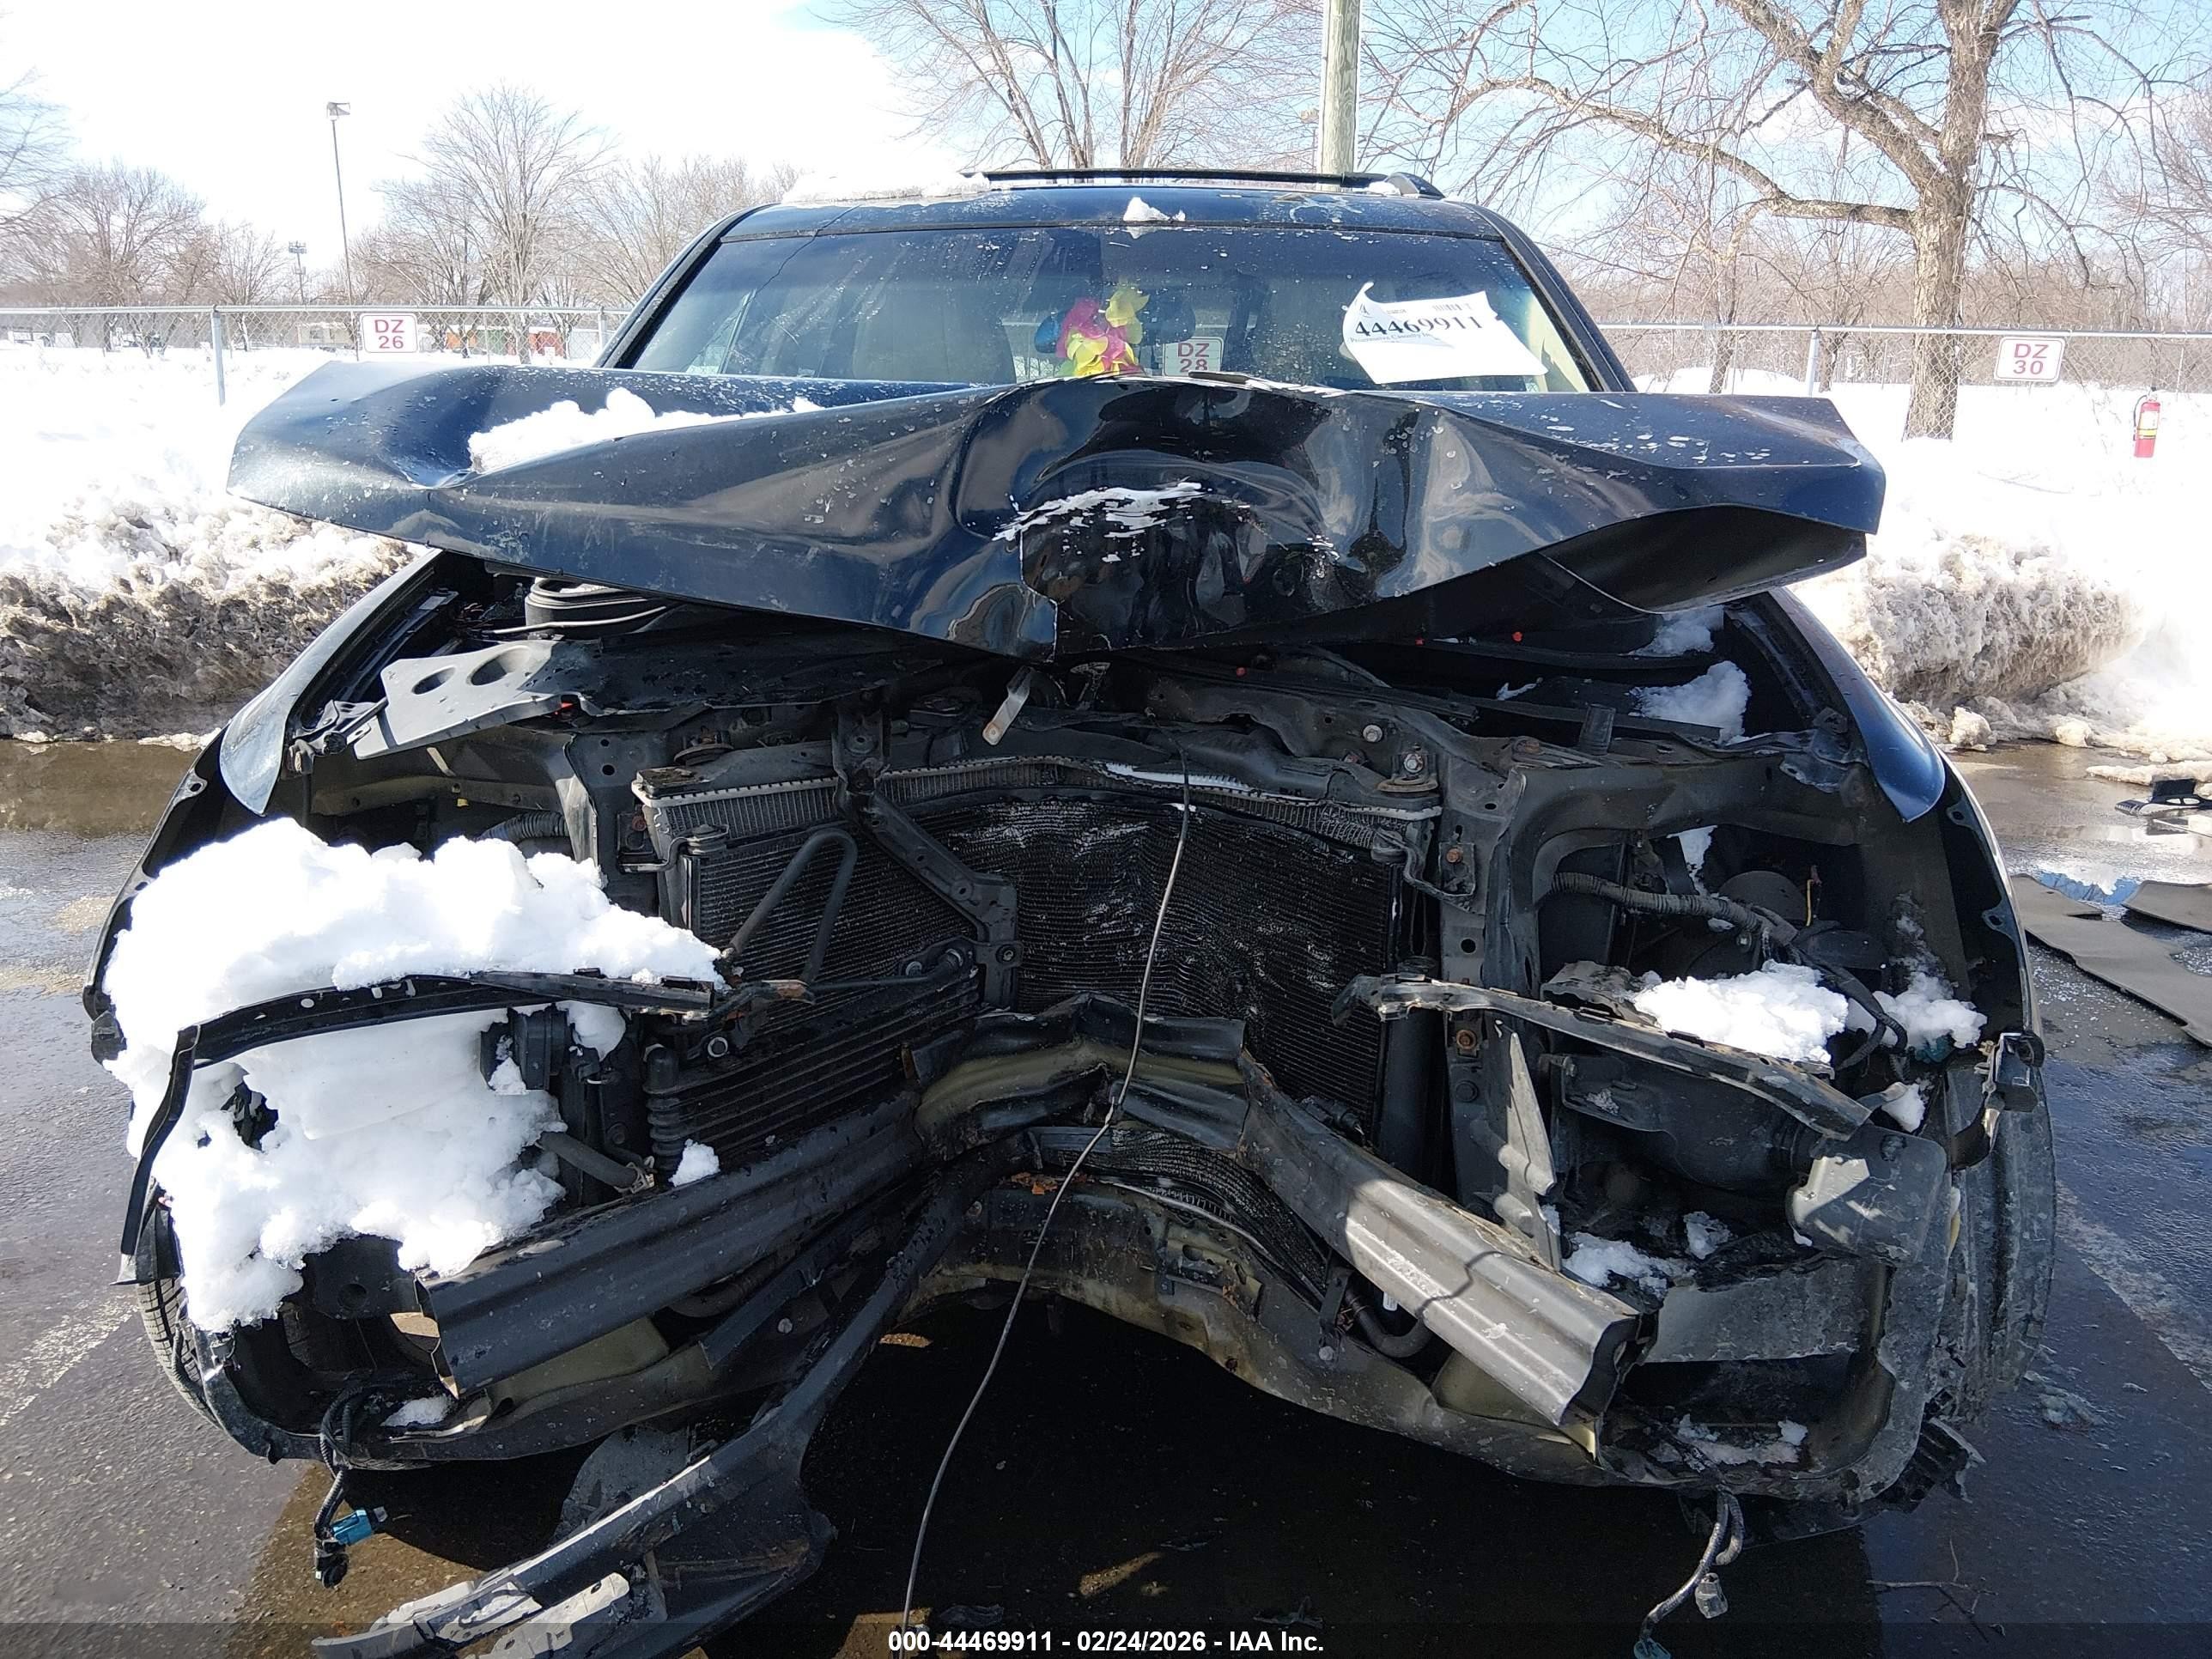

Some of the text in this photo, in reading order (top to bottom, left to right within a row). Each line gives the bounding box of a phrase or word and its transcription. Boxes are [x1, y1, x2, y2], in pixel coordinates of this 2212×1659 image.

[374, 319, 404, 333] DZ
[1355, 316, 1483, 337] 44469911
[379, 336, 404, 349] 26
[1177, 343, 1210, 357] DZ
[2014, 343, 2050, 359] DZ
[1180, 358, 1208, 373] 28
[2013, 360, 2044, 375] 30
